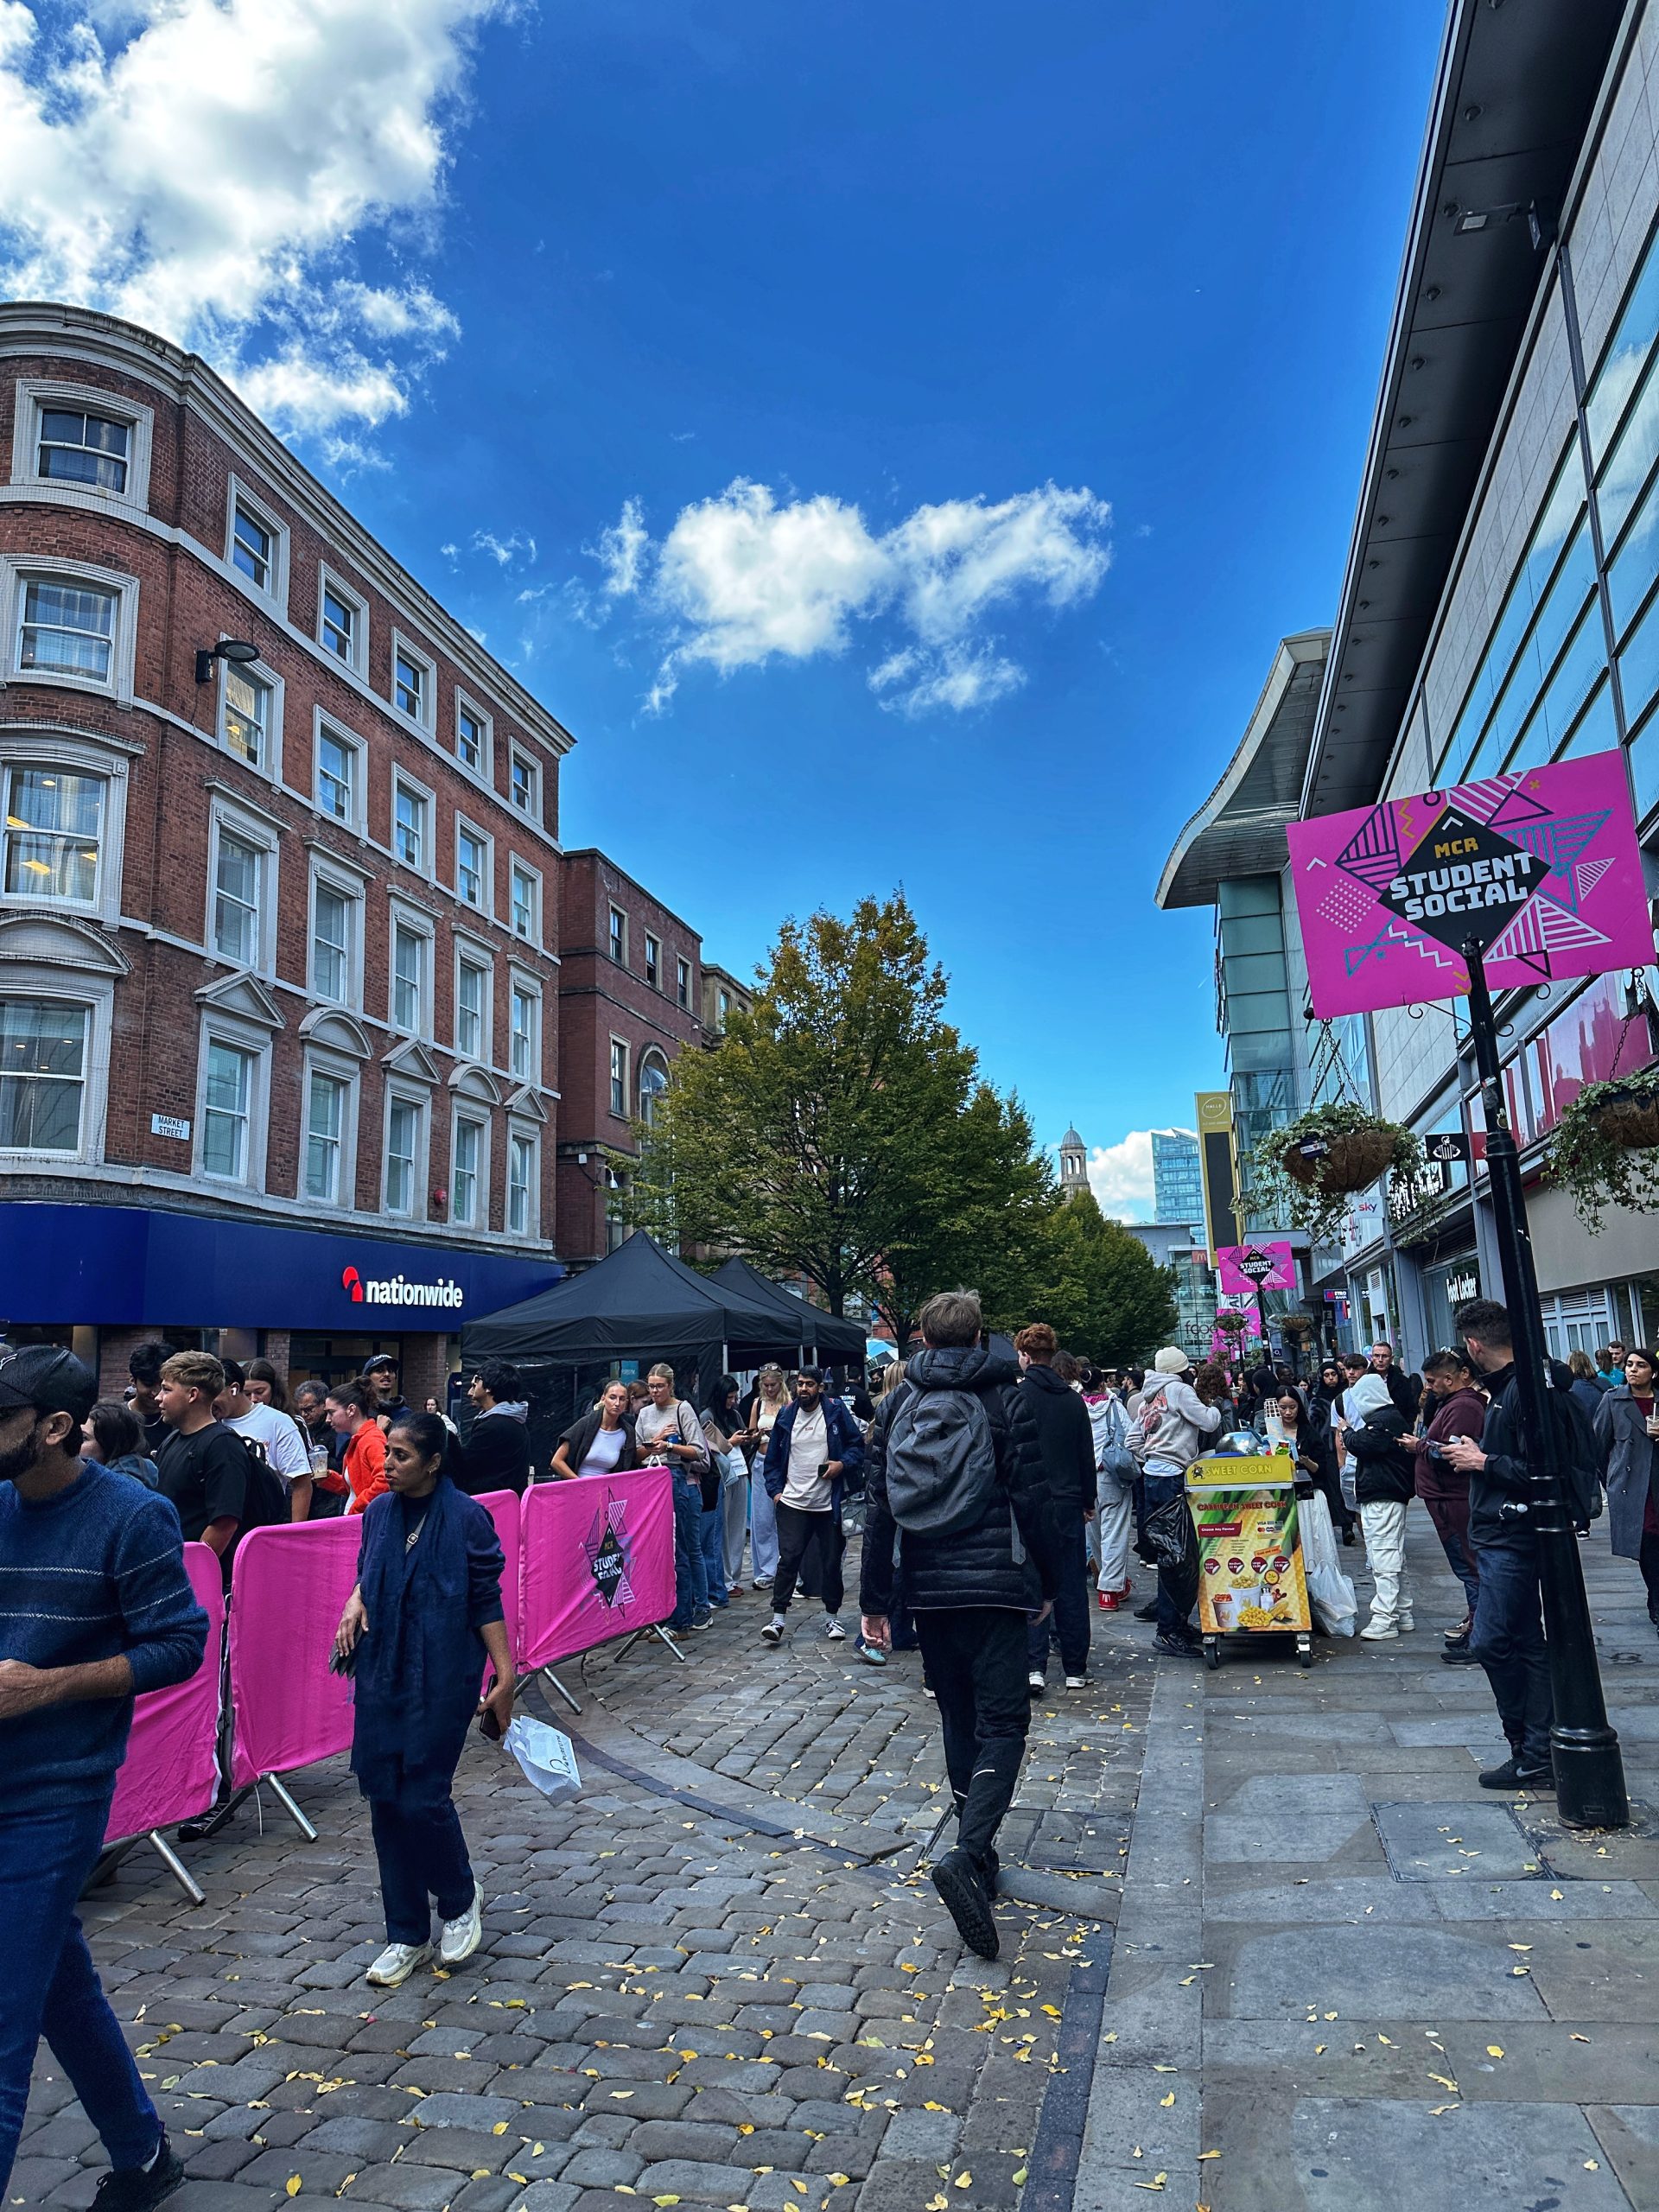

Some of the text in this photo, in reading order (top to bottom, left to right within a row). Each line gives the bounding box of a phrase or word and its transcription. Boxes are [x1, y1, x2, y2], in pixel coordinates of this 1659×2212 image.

[1434, 836, 1479, 859] MCR
[1389, 851, 1535, 901] STUDENT
[1404, 878, 1529, 921] SOCIAL
[158, 1116, 185, 1128] MARKET
[158, 1126, 183, 1137] STREET
[1358, 1202, 1377, 1213] sky
[1239, 1260, 1272, 1269] STUDENT
[1243, 1266, 1270, 1274] SOCIAL
[365, 1274, 463, 1308] nationwide
[1205, 1465, 1272, 1476] SWEET CORN
